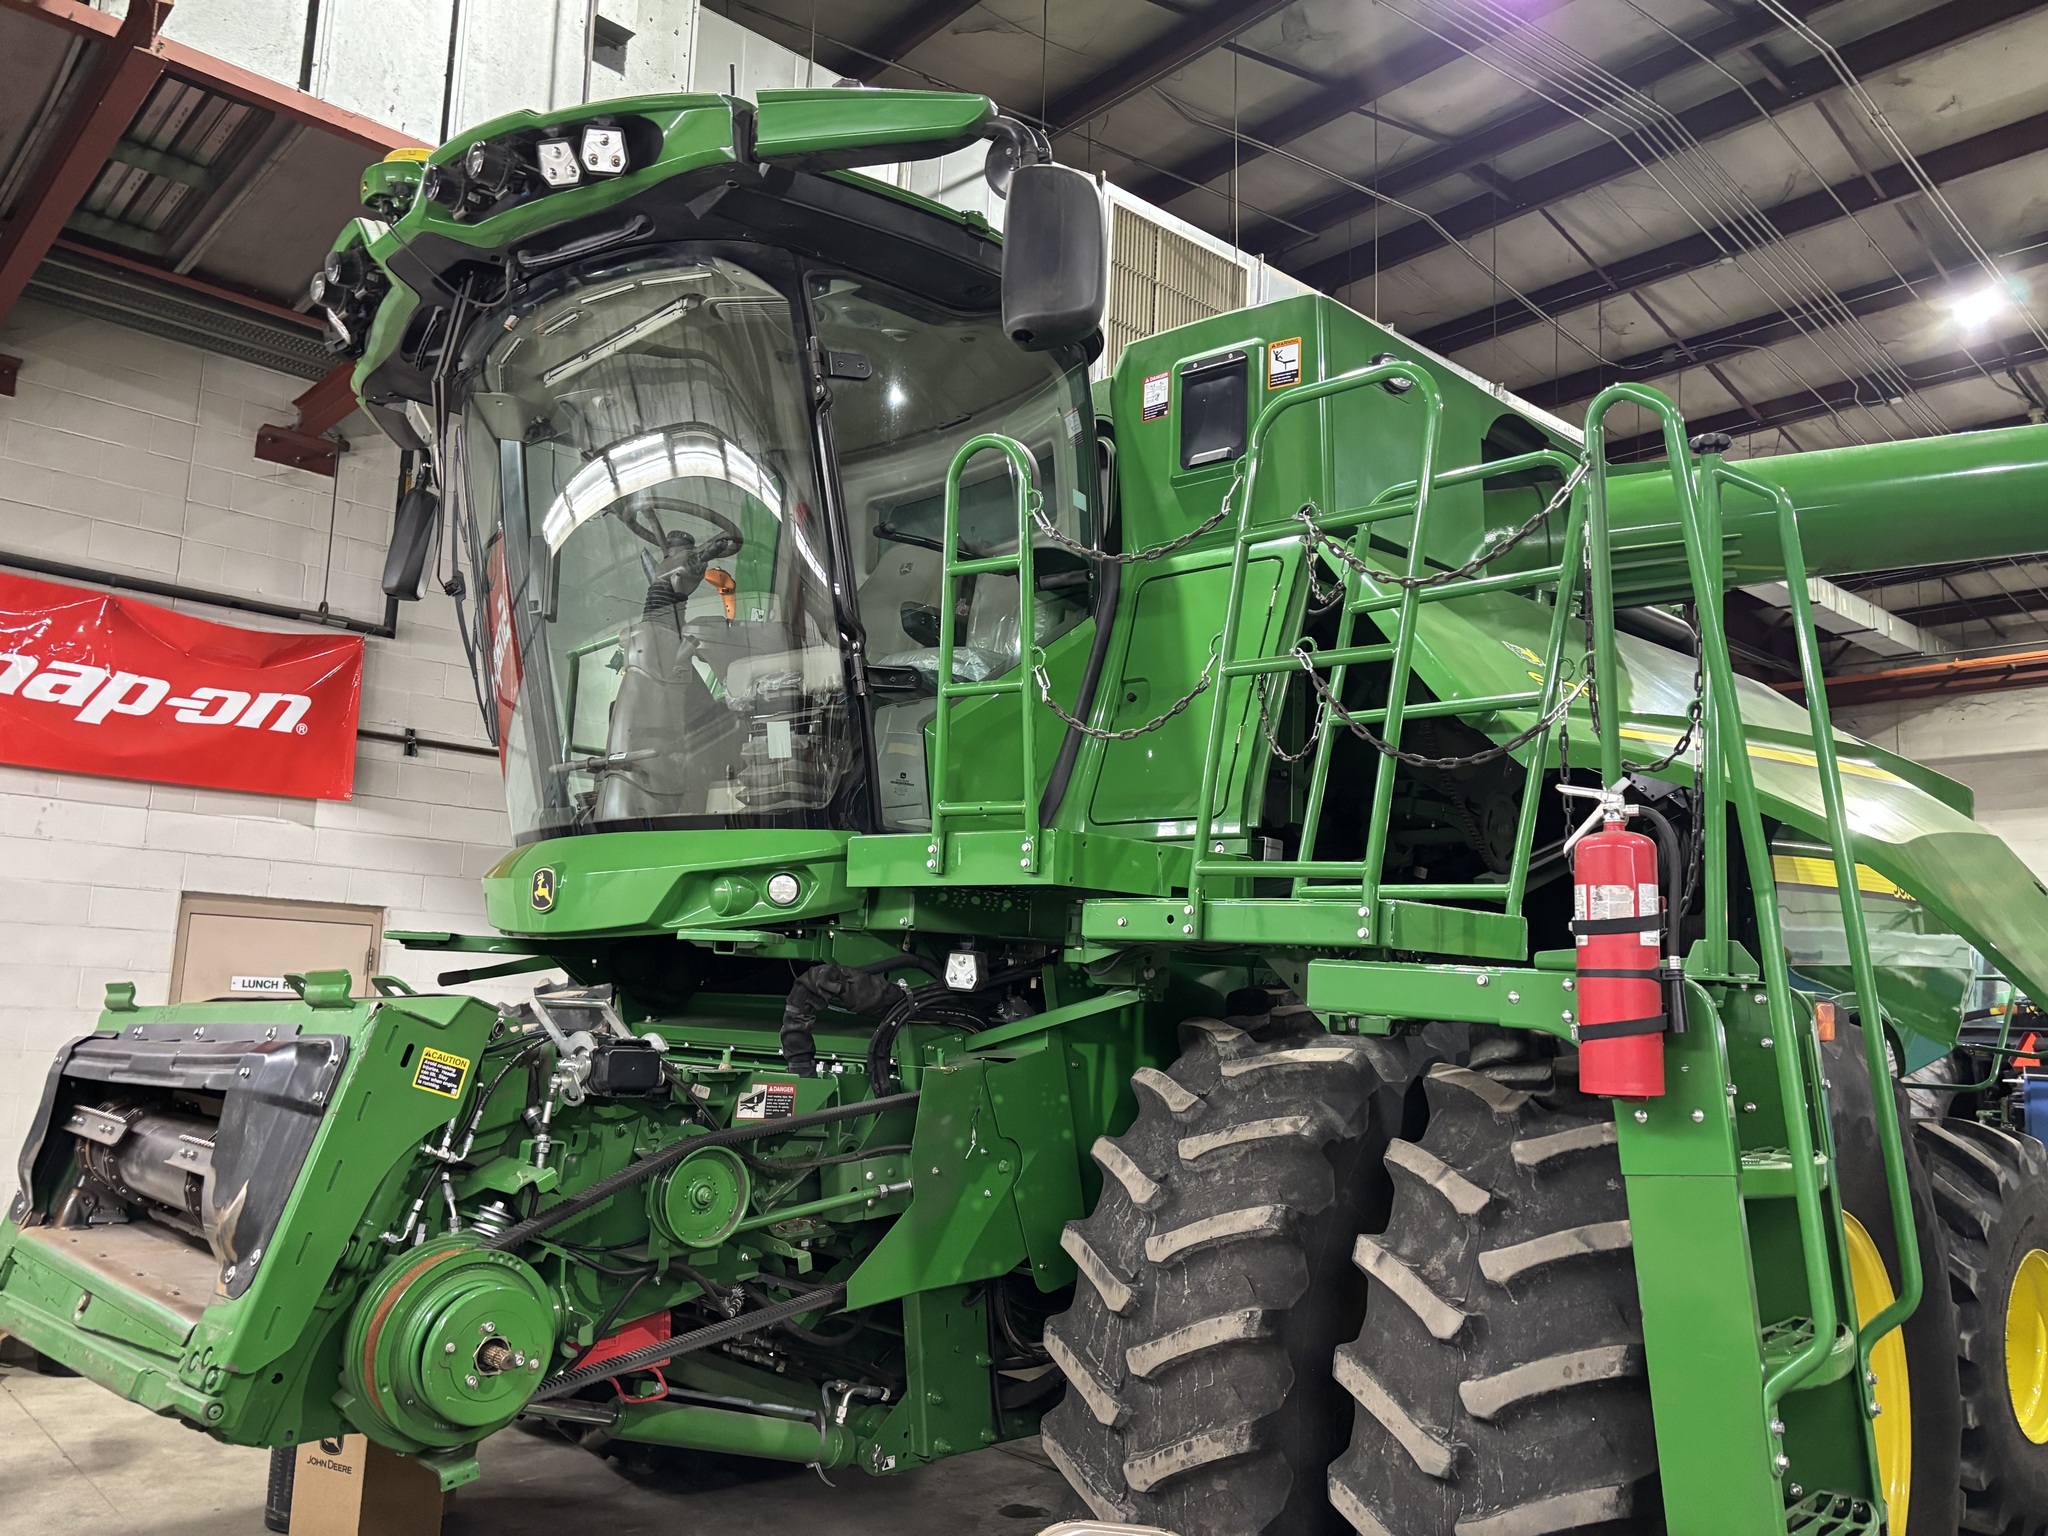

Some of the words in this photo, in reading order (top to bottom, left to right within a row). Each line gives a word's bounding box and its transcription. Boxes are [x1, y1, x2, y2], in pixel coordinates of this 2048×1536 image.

[1276, 338, 1299, 348] WARNING
[1149, 372, 1169, 382] DANGER
[242, 979, 279, 990] LUNCH
[432, 1052, 467, 1068] CAUTION
[307, 1455, 327, 1468] JOHN
[328, 1460, 352, 1474] DEERE
